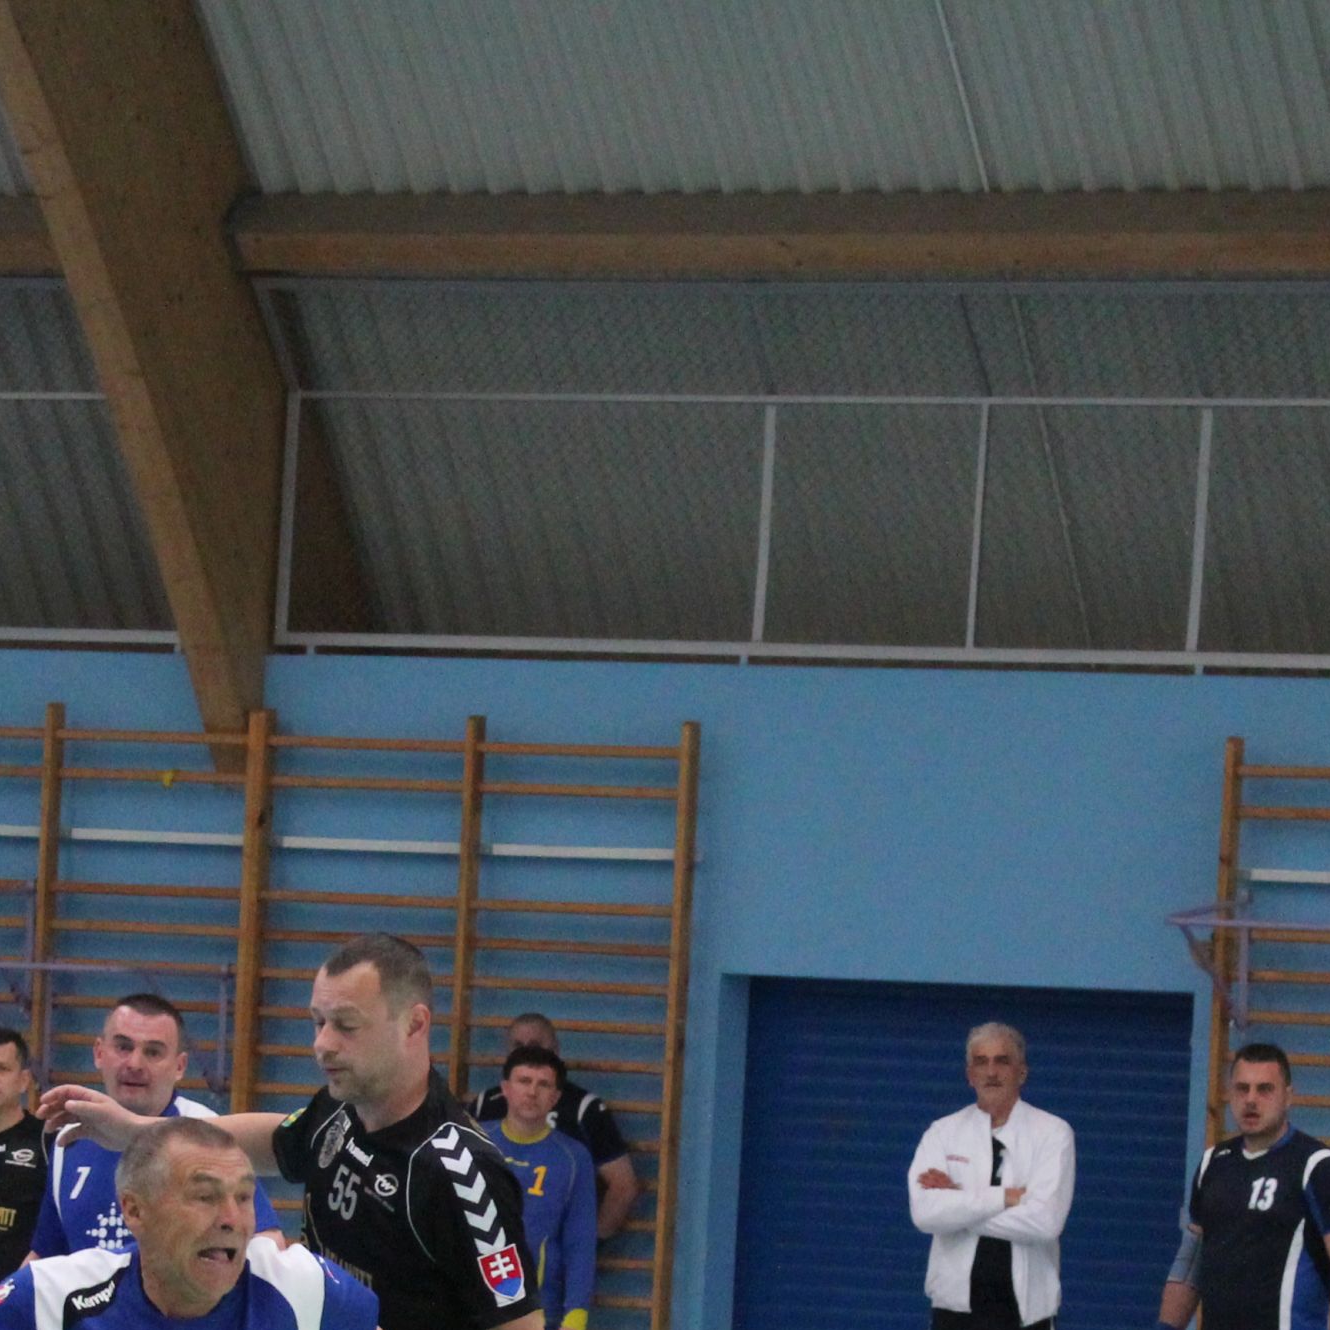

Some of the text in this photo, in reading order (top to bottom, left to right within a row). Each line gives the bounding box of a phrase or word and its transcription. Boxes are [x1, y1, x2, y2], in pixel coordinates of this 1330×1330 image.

[328, 1163, 362, 1221] 55
[527, 1165, 547, 1196] 1
[1247, 1176, 1278, 1211] 13
